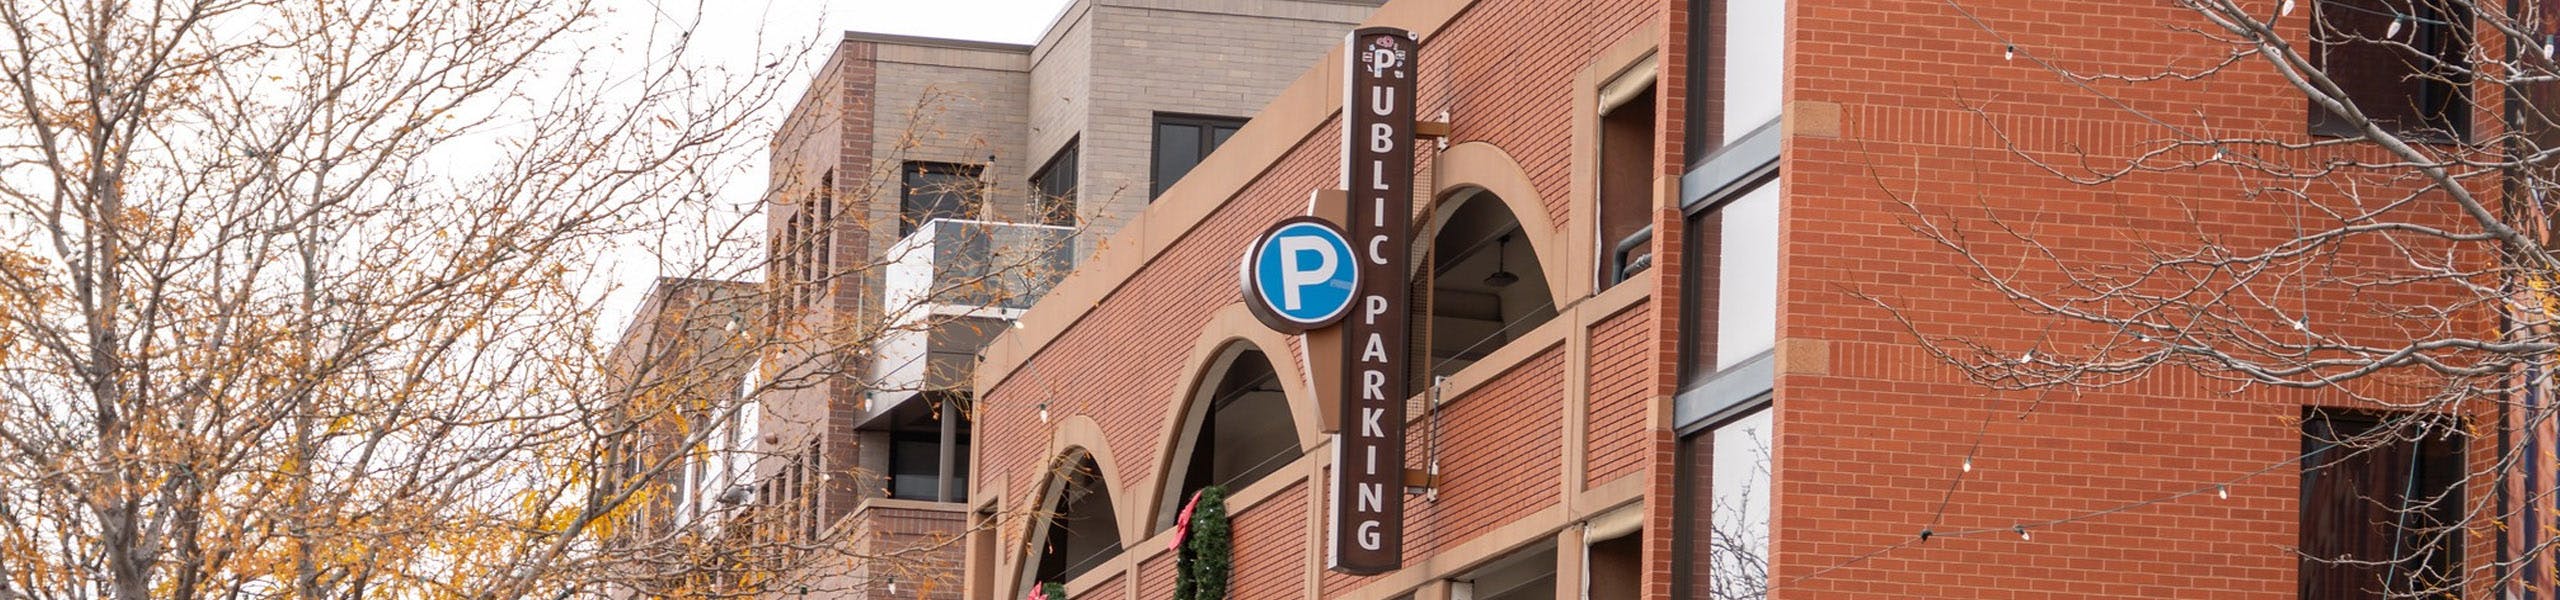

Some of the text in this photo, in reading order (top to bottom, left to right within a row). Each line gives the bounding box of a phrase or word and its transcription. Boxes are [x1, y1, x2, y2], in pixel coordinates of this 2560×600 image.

[1279, 235, 1338, 310] P
[1357, 48, 1396, 550] PUBLIC PARKING
